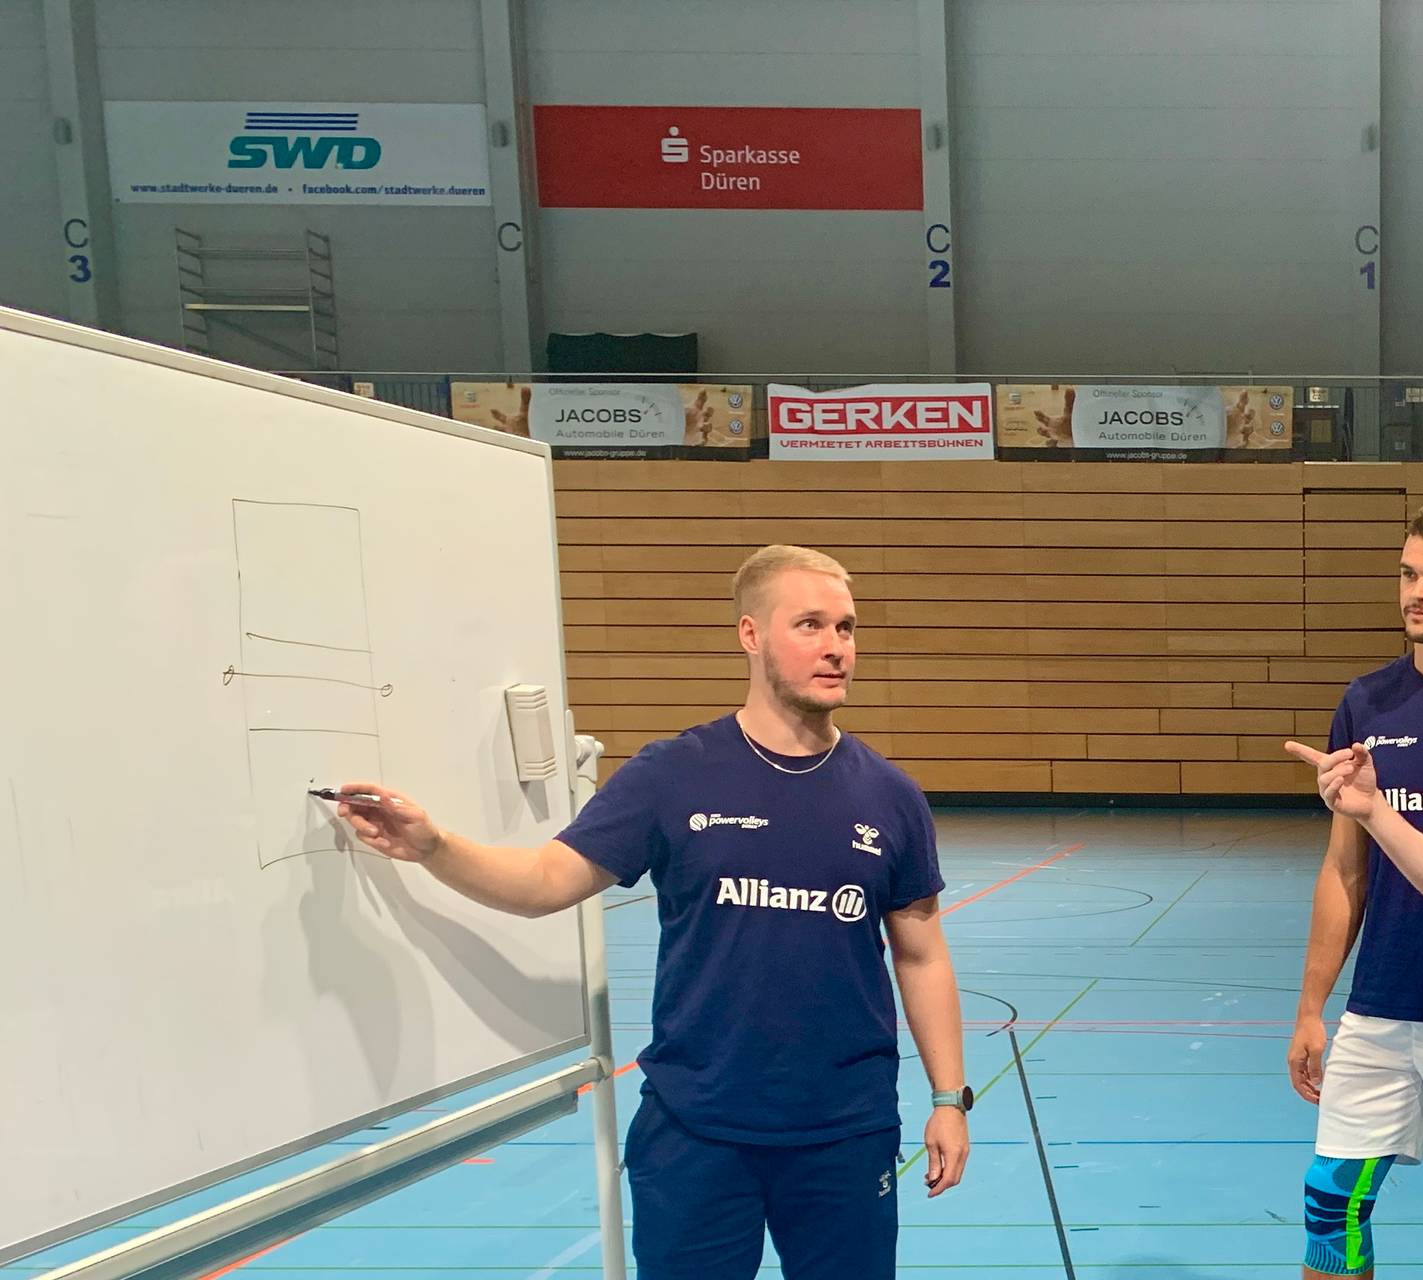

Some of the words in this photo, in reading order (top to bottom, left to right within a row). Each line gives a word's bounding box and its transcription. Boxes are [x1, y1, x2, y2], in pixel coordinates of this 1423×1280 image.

[227, 136, 382, 170] SWD
[699, 144, 801, 168] Sparkasse
[130, 183, 278, 194] www.stadtwerke-dueren.de
[302, 183, 486, 196] facebook.com/stadtwerke.dueren
[700, 172, 761, 191] Düren
[64, 218, 89, 248] C
[497, 222, 522, 252] C
[926, 224, 951, 254] C
[1354, 225, 1379, 255] C
[70, 254, 91, 283] 3
[928, 259, 951, 288] 2
[1359, 261, 1376, 290] 1
[554, 408, 642, 423] JACOBS
[778, 400, 984, 431] GERKEN
[1098, 410, 1184, 426] JACOBS
[555, 428, 624, 439] Automobile
[629, 428, 665, 439] Düren
[780, 439, 863, 449] VERMIETET
[864, 438, 984, 449] ARBEITSBÜHNEN
[1098, 431, 1167, 441] Automobile
[1170, 432, 1207, 442] Düren
[708, 815, 769, 828] powervolleys
[716, 877, 827, 912] Allianz
